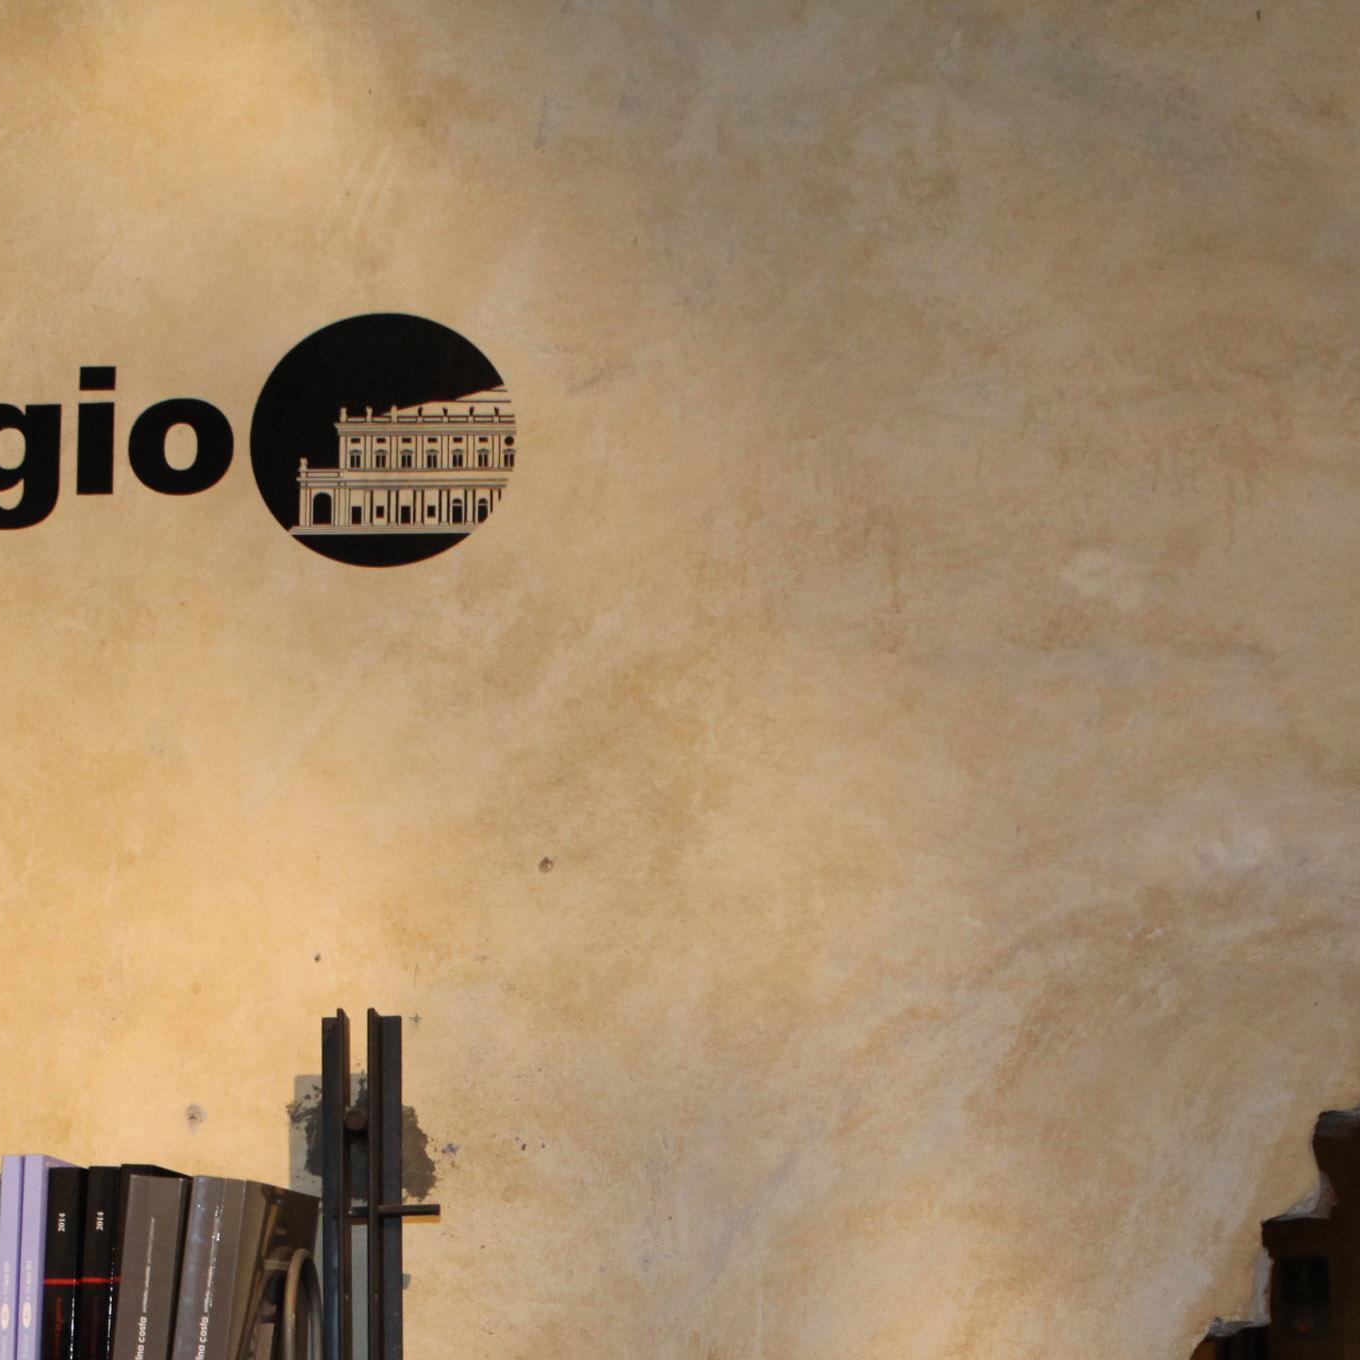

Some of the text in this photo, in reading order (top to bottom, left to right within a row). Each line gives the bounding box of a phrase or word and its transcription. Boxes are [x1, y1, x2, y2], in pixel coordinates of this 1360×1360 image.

[57, 1213, 66, 1232] 2014
[96, 1211, 104, 1231] 2014
[138, 1317, 147, 1343] costa
[197, 1317, 208, 1343] costa
